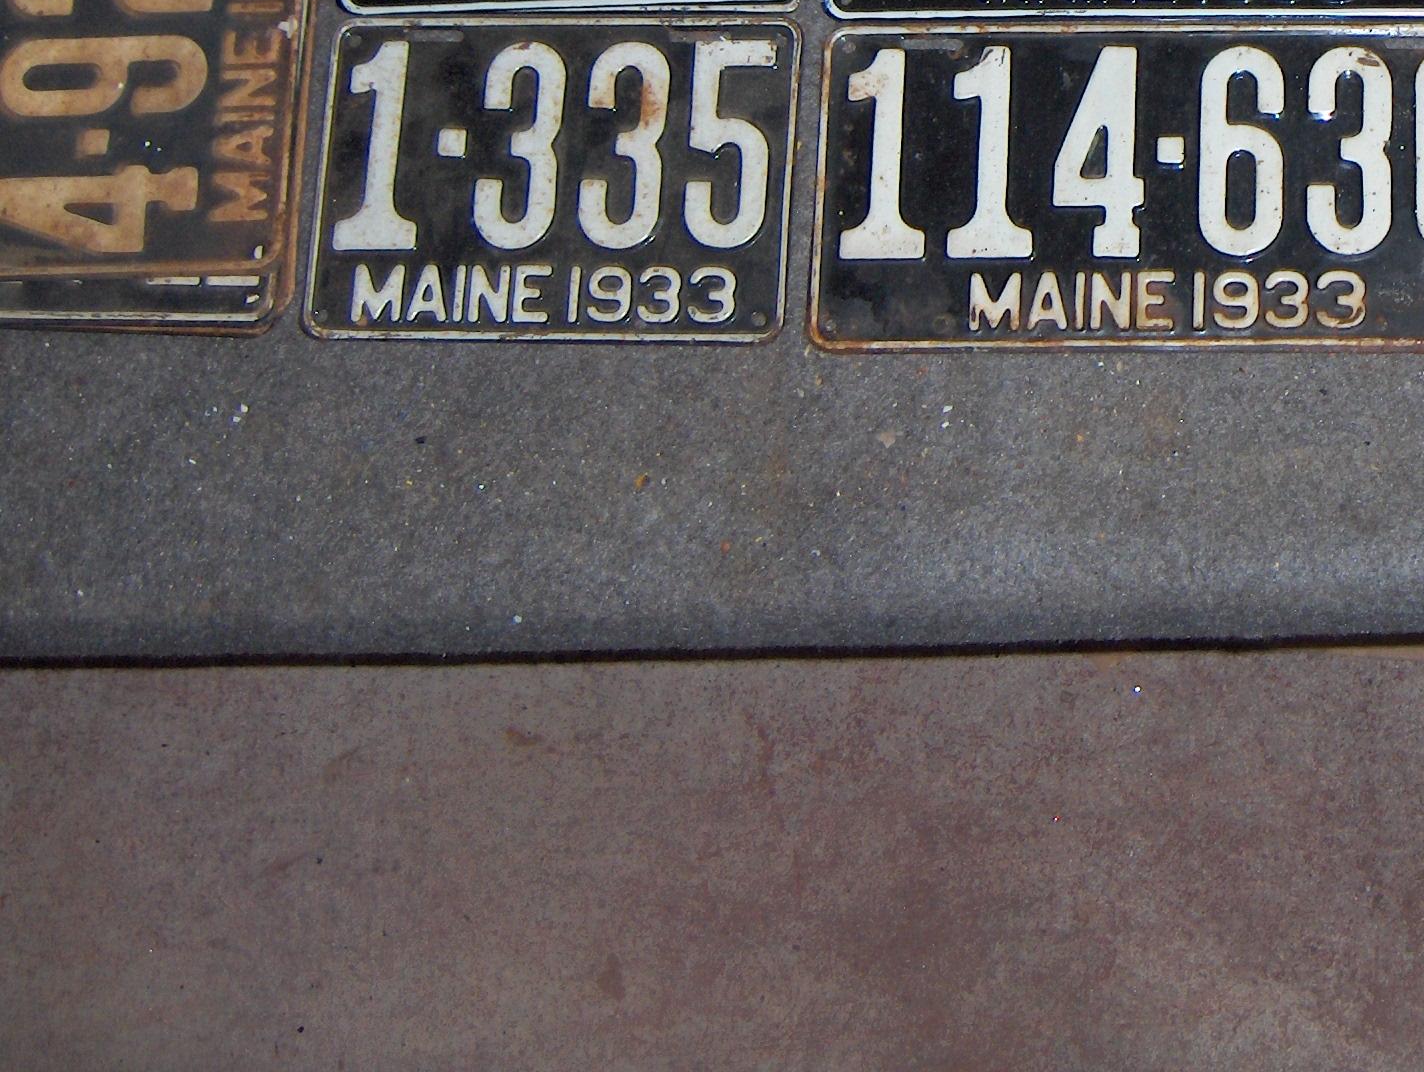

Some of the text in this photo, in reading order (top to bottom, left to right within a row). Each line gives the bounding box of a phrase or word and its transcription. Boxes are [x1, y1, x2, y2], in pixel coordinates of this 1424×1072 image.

[208, 29, 284, 223] MAINE
[350, 263, 737, 324] MAINE 1933
[968, 271, 1367, 331] MAINE 1933
